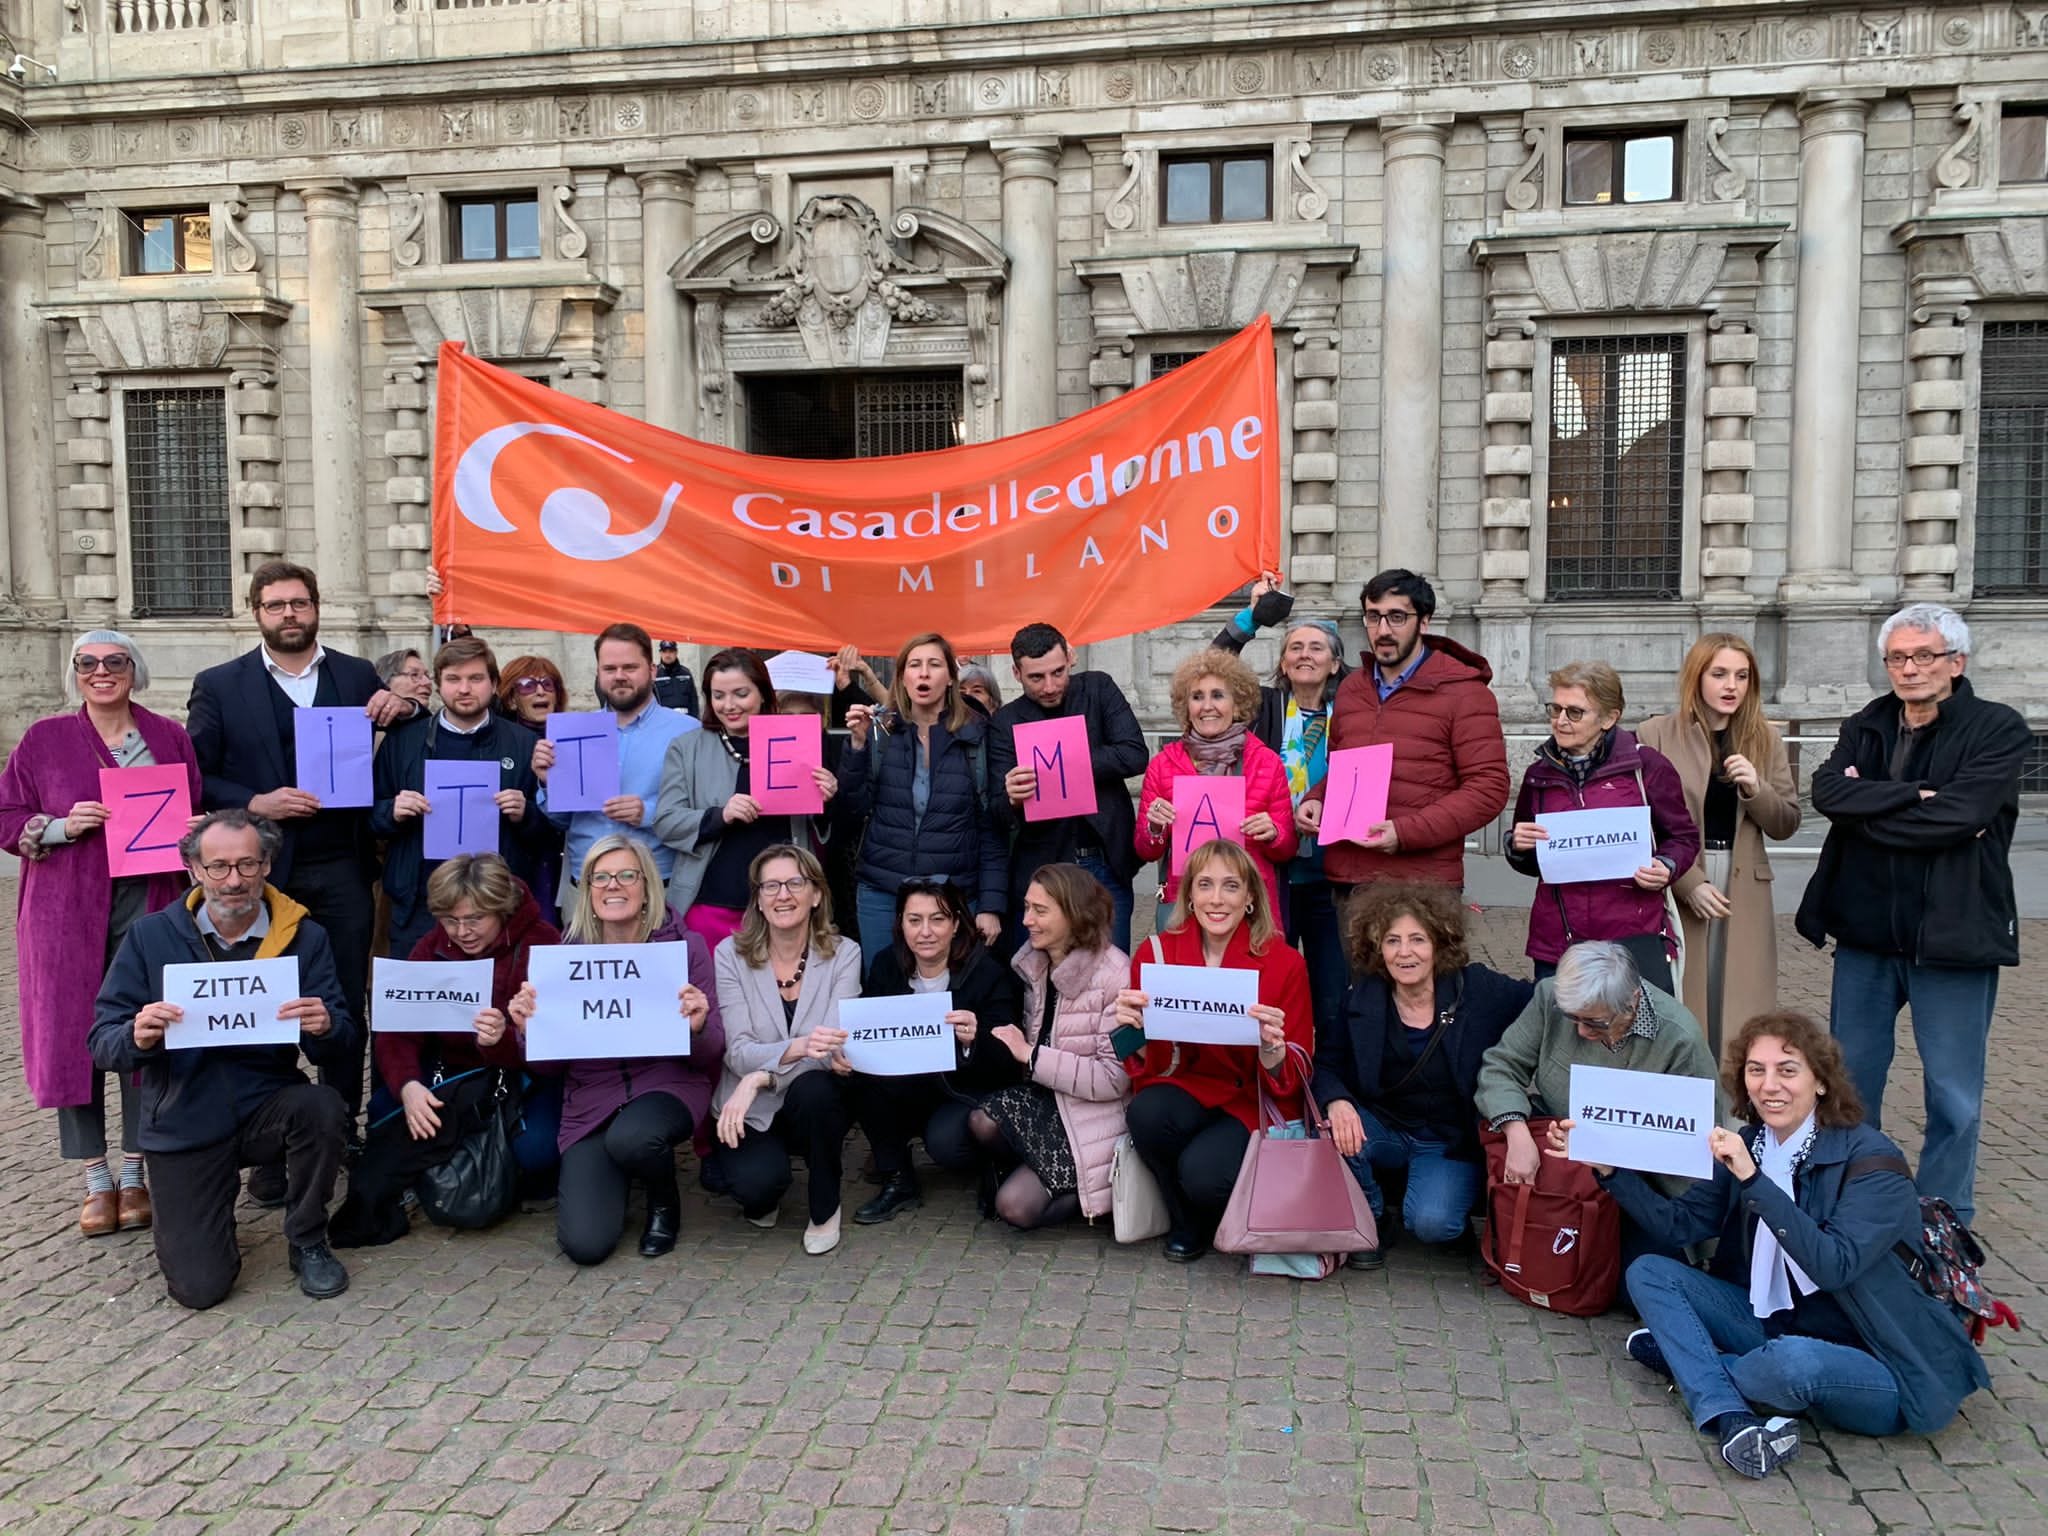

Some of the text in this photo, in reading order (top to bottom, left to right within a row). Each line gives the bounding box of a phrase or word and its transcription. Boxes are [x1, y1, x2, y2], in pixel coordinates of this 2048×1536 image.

[732, 414, 1263, 540] Casadelledonne
[771, 504, 1241, 592] DI MILANO
[555, 733, 608, 797] T
[766, 735, 800, 791] E
[1032, 740, 1068, 802] M
[123, 788, 178, 853] Z
[437, 784, 489, 845] T
[1184, 792, 1222, 853] A
[1547, 831, 1638, 849] #ZITTAMAI
[569, 959, 641, 981] ZITTA
[192, 975, 267, 999] ZITTA
[384, 988, 480, 1003] #ZITTAMAI
[583, 998, 631, 1020] MAI
[1153, 996, 1245, 1015] #ZITTAMAI
[207, 1011, 256, 1032] MAI
[852, 1023, 941, 1041] #ZITTAMAI
[1582, 1105, 1696, 1132] #ZITTAMAI
